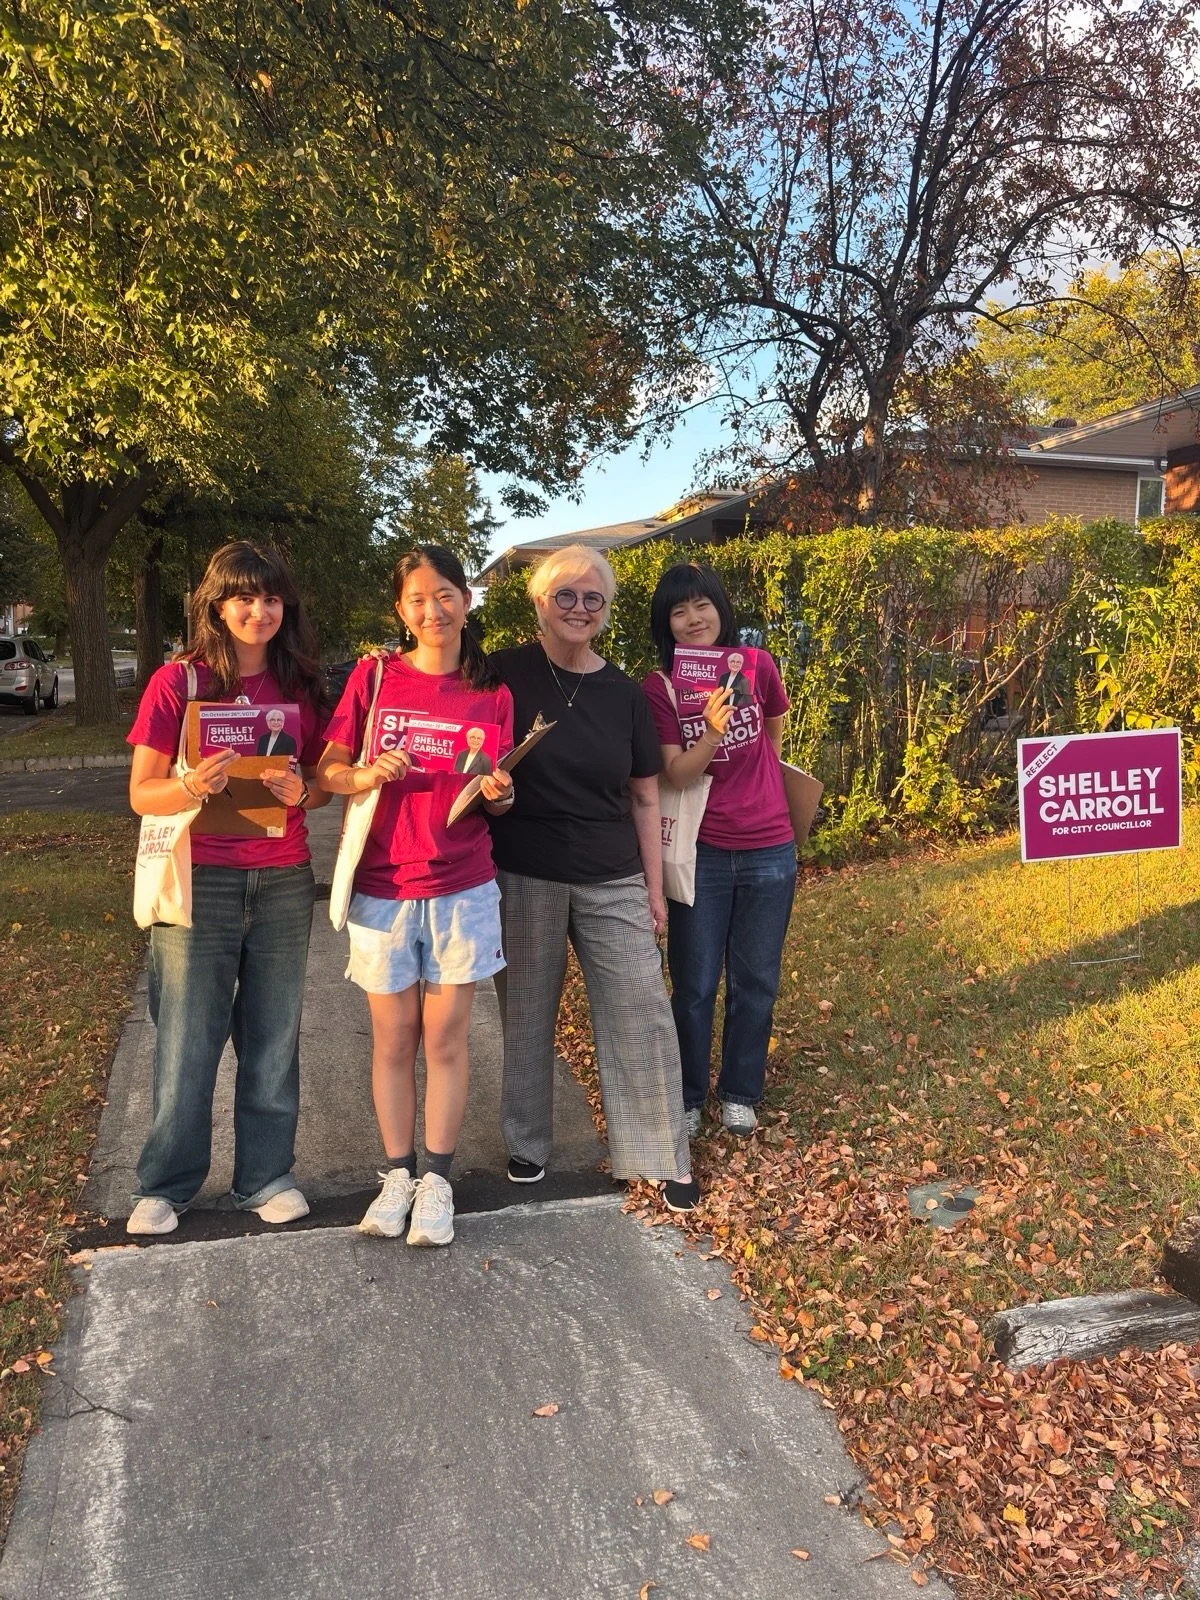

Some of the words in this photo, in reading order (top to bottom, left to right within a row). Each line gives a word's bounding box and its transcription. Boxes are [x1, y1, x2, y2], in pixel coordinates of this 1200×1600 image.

[681, 663, 717, 672] SHELLEY
[681, 670, 717, 678] CARROLL
[683, 691, 713, 701] CARROL
[683, 703, 760, 738] SHLEY
[210, 726, 254, 735] SHELLEY
[210, 734, 255, 743] CARROLL
[413, 735, 455, 748] SHELLEY
[412, 743, 455, 756] CARROLL
[1025, 744, 1058, 778] RE-ELECT
[1038, 767, 1162, 798] SHELLEY
[1039, 793, 1165, 823] CARROLL
[1052, 827, 1069, 835] FOR
[1070, 824, 1093, 834] CITY
[1095, 819, 1152, 832] COUNCILLOR
